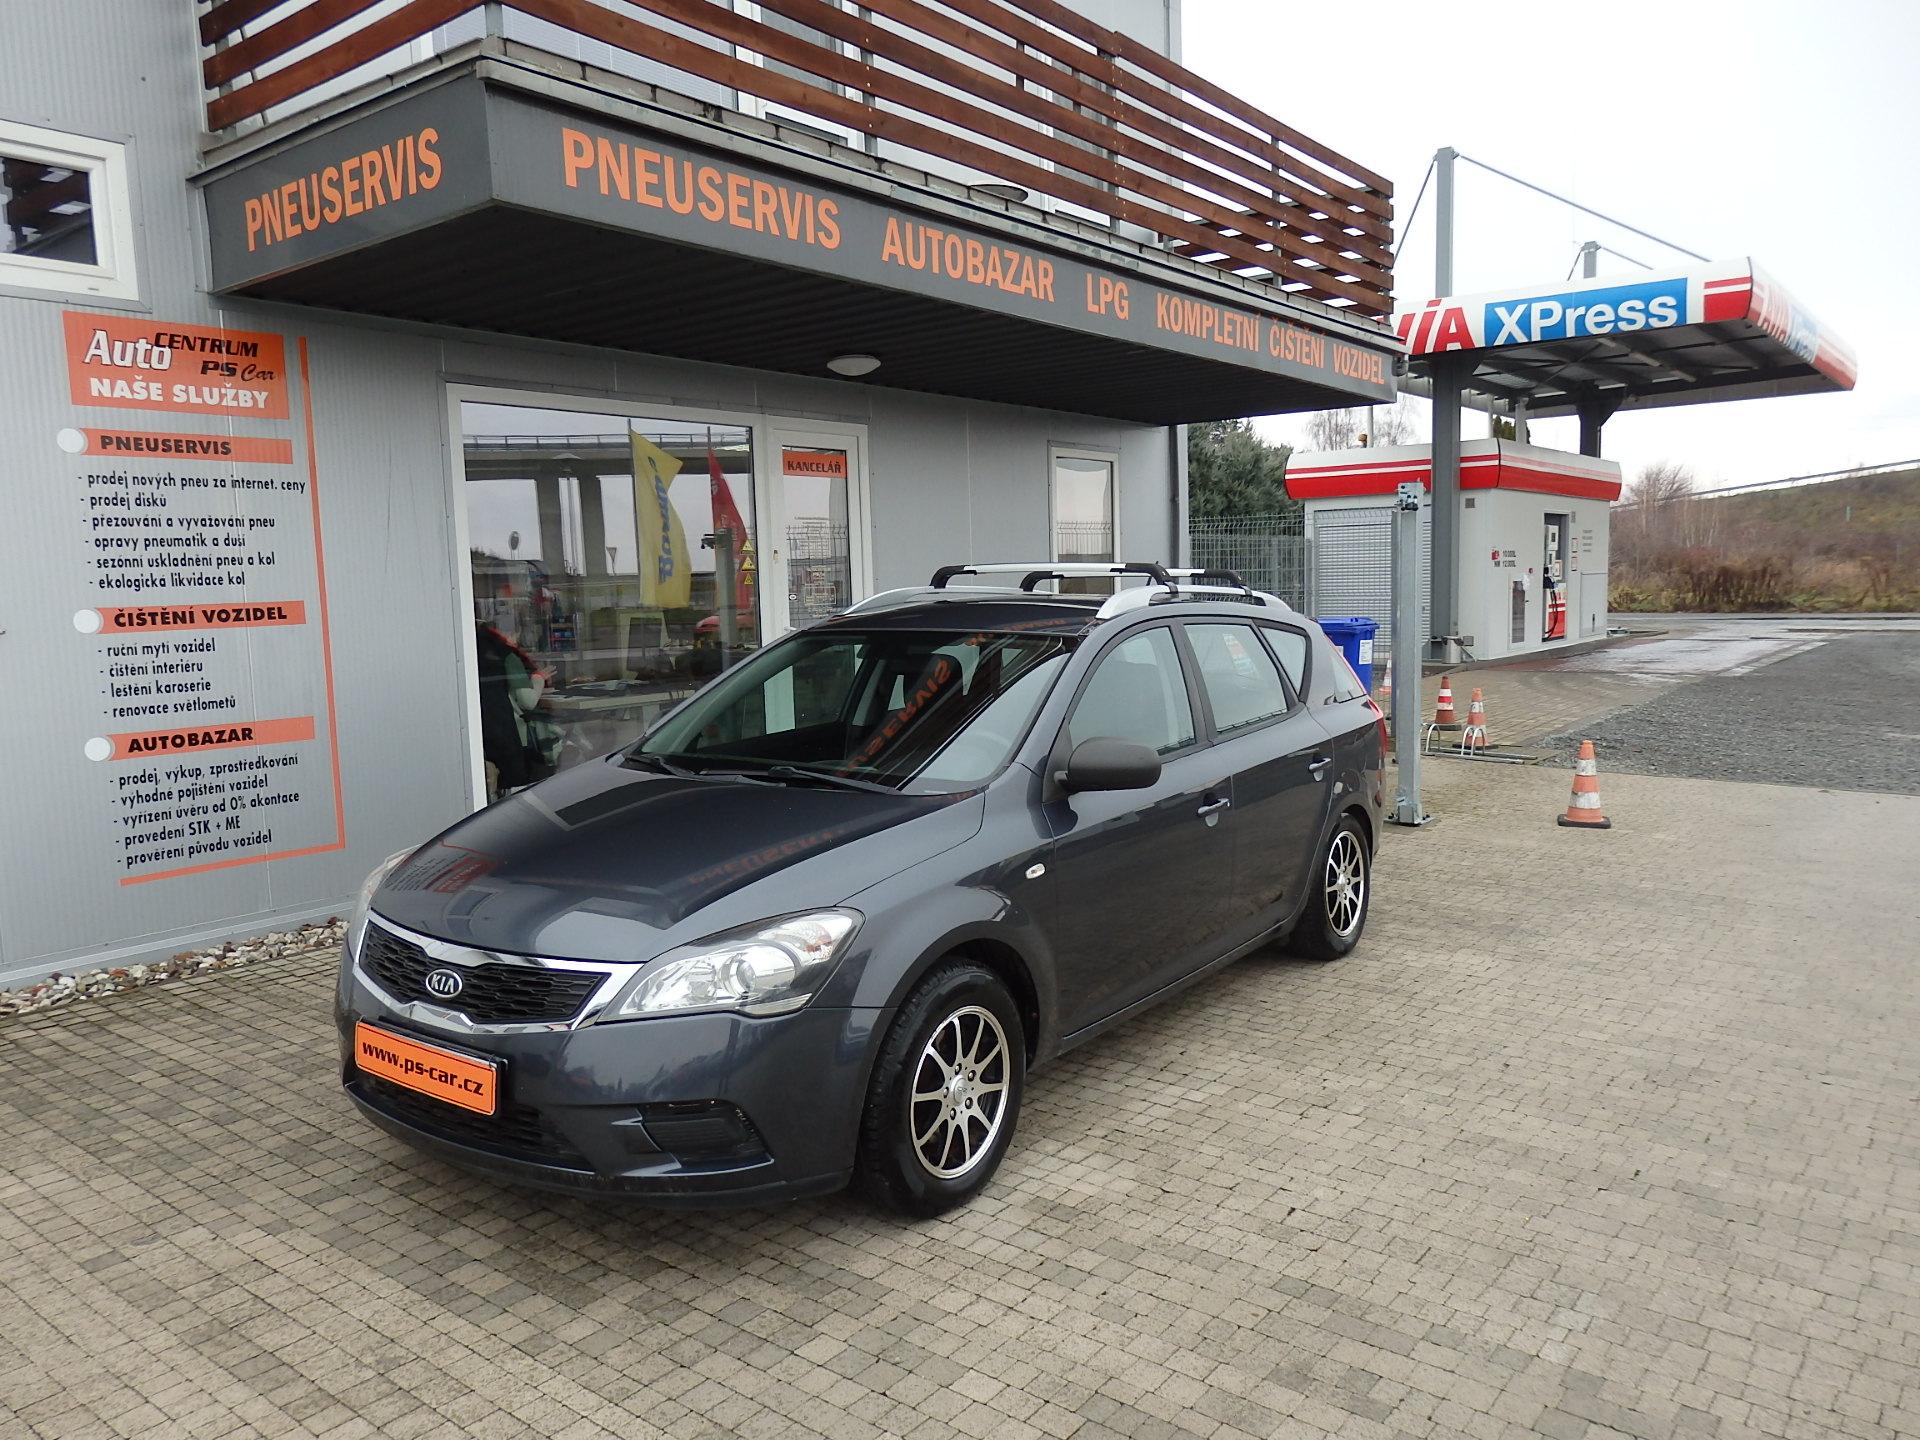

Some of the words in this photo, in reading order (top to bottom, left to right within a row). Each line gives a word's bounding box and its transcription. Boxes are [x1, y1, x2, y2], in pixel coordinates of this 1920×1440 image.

[244, 126, 443, 253] PNEUSERVIS
[561, 126, 842, 250] PNEUSERVIS
[881, 217, 1054, 303] AUTOBAZAR
[1085, 274, 1130, 320] LPG
[1156, 293, 1262, 353] KOMPLETNÍ
[1268, 315, 1326, 369] ČIŠTĚNÍ
[1332, 343, 1386, 385] VOZIDEL
[1492, 294, 1680, 346] XPress
[83, 328, 172, 371] Auto
[154, 332, 258, 358] CENTRUM
[200, 360, 239, 378] PS
[240, 364, 277, 382] Car
[90, 374, 164, 402] NAŠE
[173, 382, 269, 409] SLUŽBY
[100, 435, 232, 456] PNEUSERVIS
[88, 471, 129, 489] prodej
[132, 473, 176, 491] nových
[181, 477, 209, 491] pneu
[213, 477, 227, 488] za
[281, 481, 306, 494] ceny
[90, 492, 131, 510] prodej
[166, 517, 174, 527] a
[249, 517, 275, 531] pneu
[94, 537, 139, 552] opravy
[144, 534, 208, 551] pneumatik
[212, 536, 219, 547] a
[216, 556, 243, 569] pneu
[247, 556, 254, 566] a
[258, 552, 275, 566] kol
[99, 574, 166, 592] ekologická
[171, 572, 224, 587] likvidace
[228, 571, 246, 586] kol
[114, 606, 196, 628] ČIŠTĚNÍ
[202, 606, 288, 624] VOZIDEL
[174, 637, 216, 653] vozidel
[156, 678, 211, 694] karoserie
[113, 703, 169, 719] renovace
[128, 727, 254, 753] AUTOBAZAR
[229, 774, 268, 792] vozidel
[212, 799, 227, 814] od
[250, 791, 300, 809] akontace
[125, 828, 185, 849] provedení
[188, 819, 211, 837] STK
[225, 815, 241, 832] ME
[233, 829, 272, 848] vozidel
[430, 974, 455, 994] KIA
[362, 1041, 484, 1097] www.ps-car.cz
